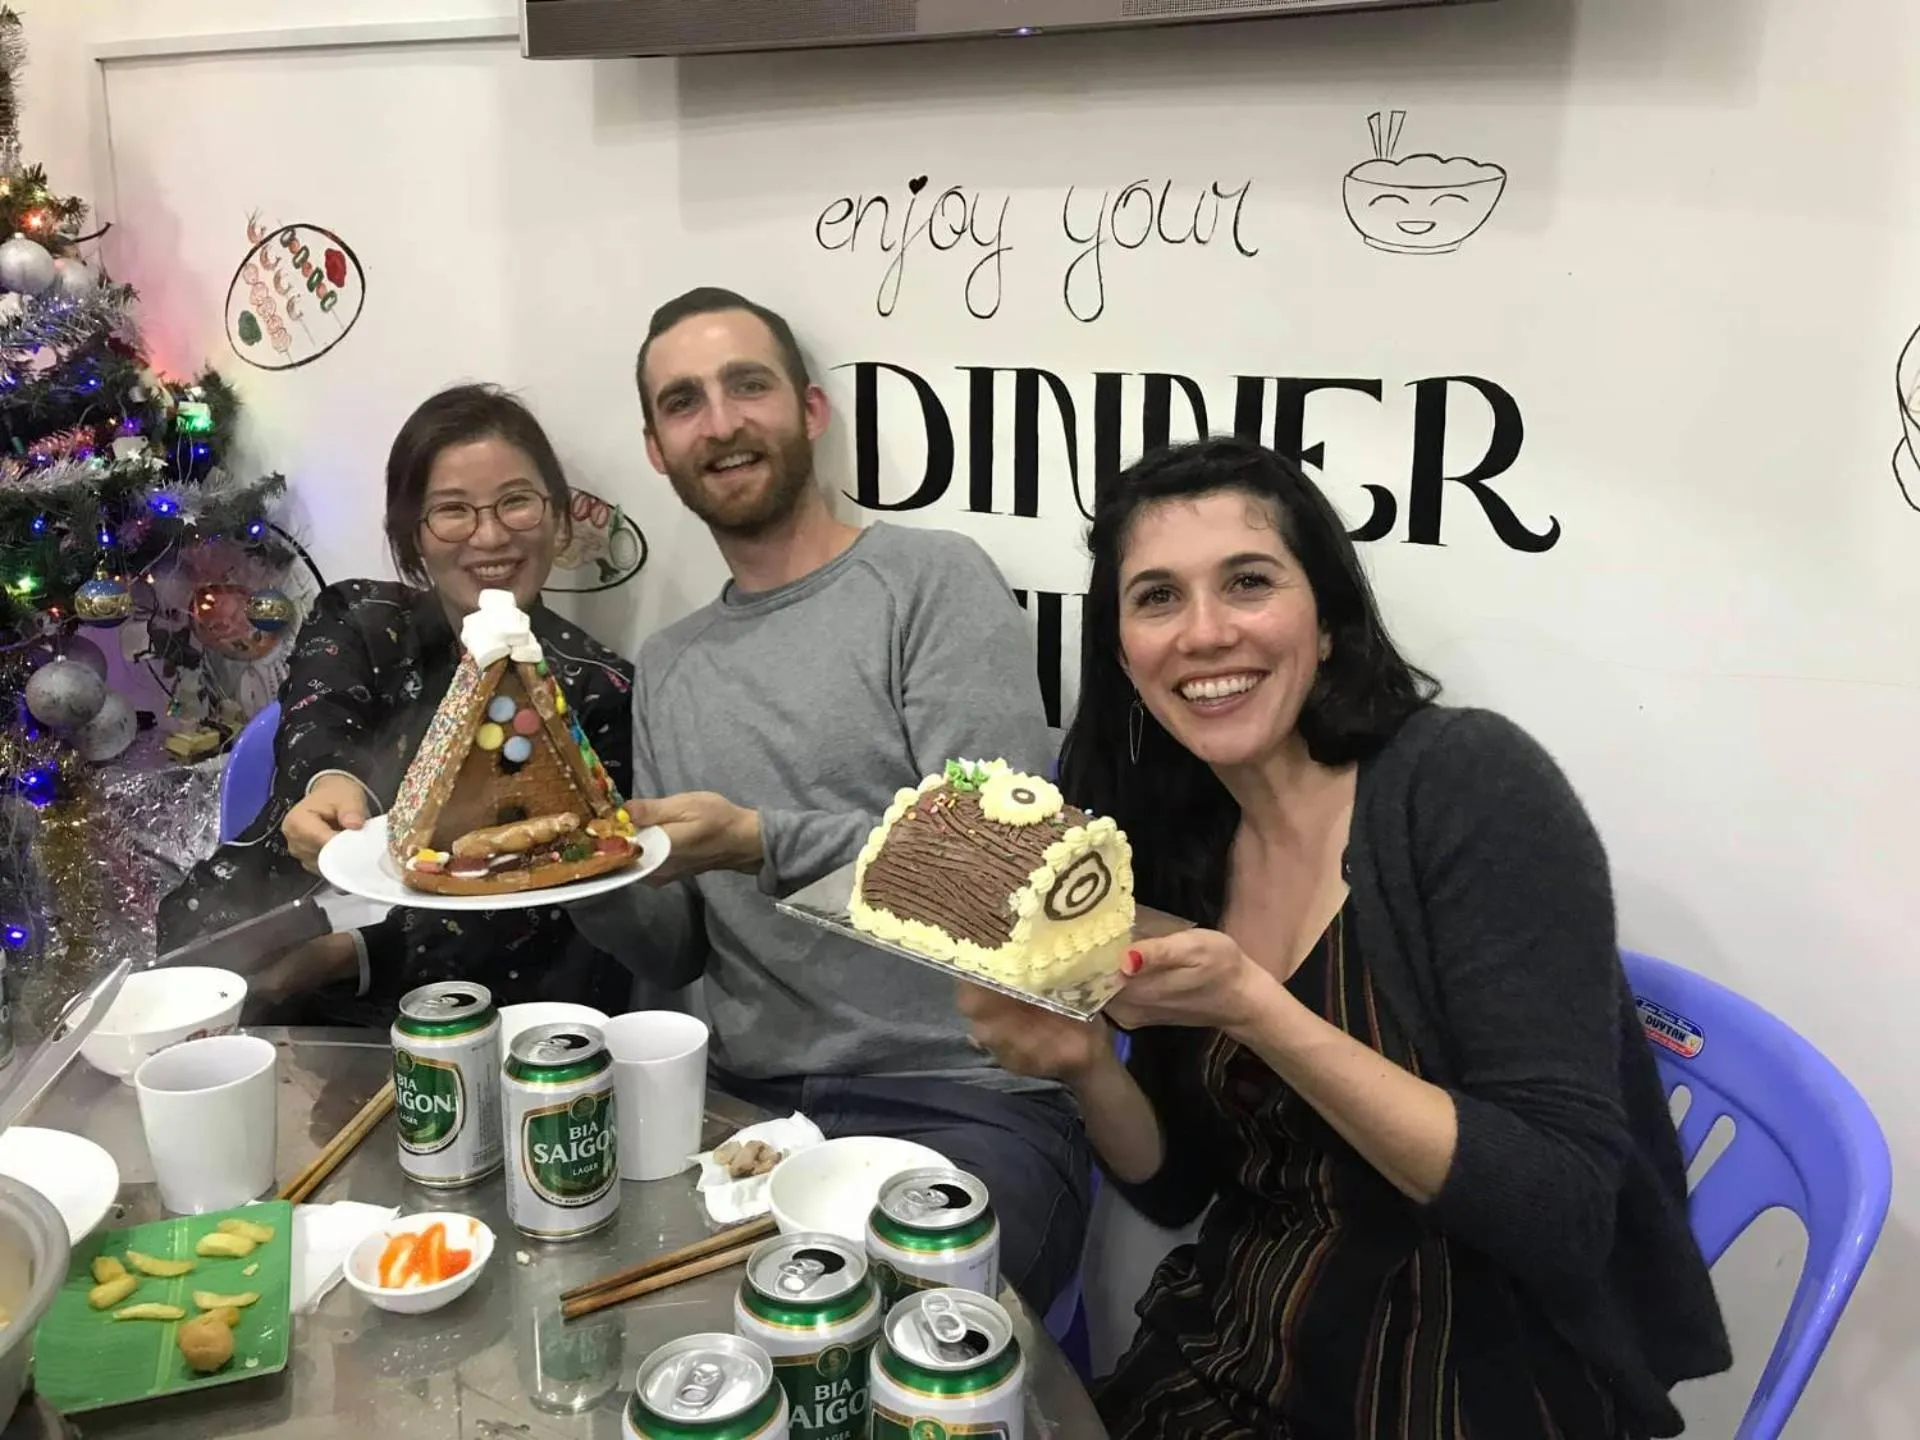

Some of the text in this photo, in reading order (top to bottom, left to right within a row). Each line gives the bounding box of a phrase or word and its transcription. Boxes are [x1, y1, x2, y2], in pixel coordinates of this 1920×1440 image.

[816, 175, 1259, 322] enjoy your
[397, 1073, 418, 1091] BIA
[398, 1087, 452, 1114] IGON
[569, 1121, 599, 1140] BIA
[814, 1378, 853, 1401] BIA
[787, 1388, 869, 1429] AIGO
